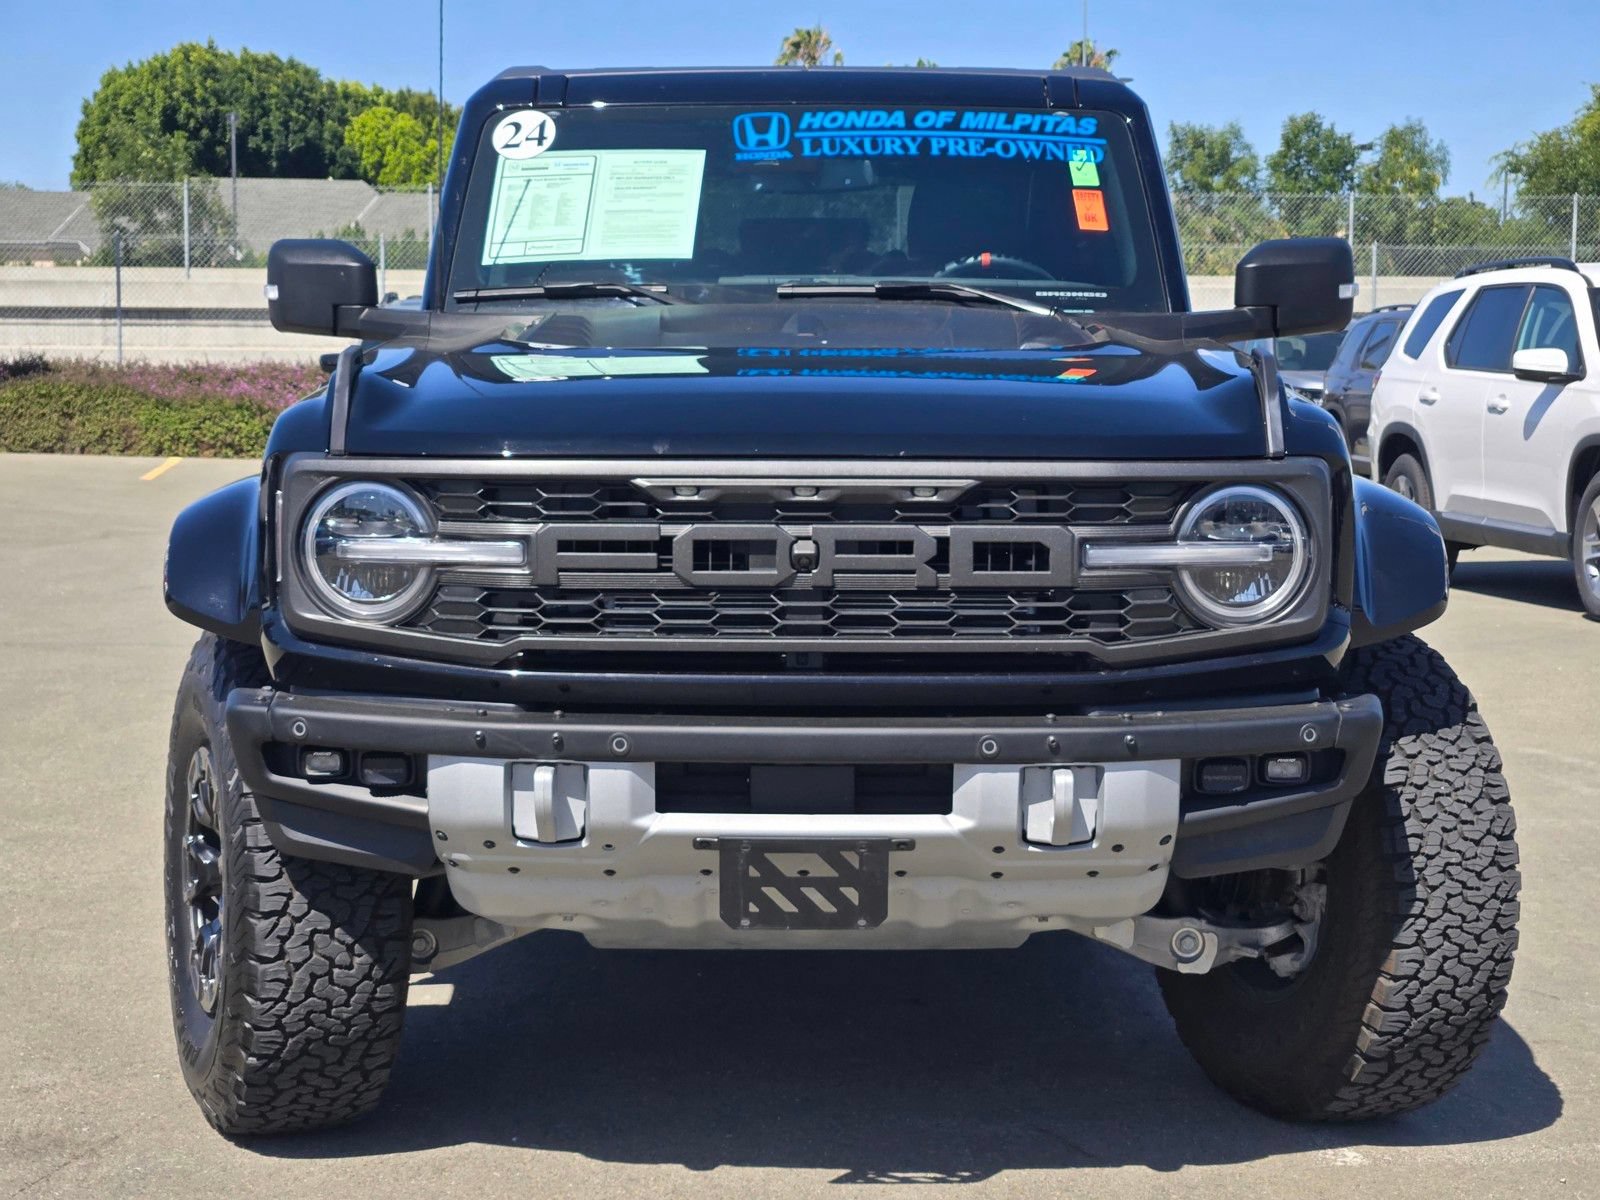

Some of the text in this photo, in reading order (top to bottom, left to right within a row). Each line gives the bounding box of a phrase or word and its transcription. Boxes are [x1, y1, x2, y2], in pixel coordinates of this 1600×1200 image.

[500, 119, 548, 149] 24
[799, 110, 1098, 135] HONDA OF MILPITAS
[735, 151, 794, 161] HONDA
[801, 136, 1104, 163] LUXURY PRE-OWNED
[535, 523, 1074, 588] FORD
